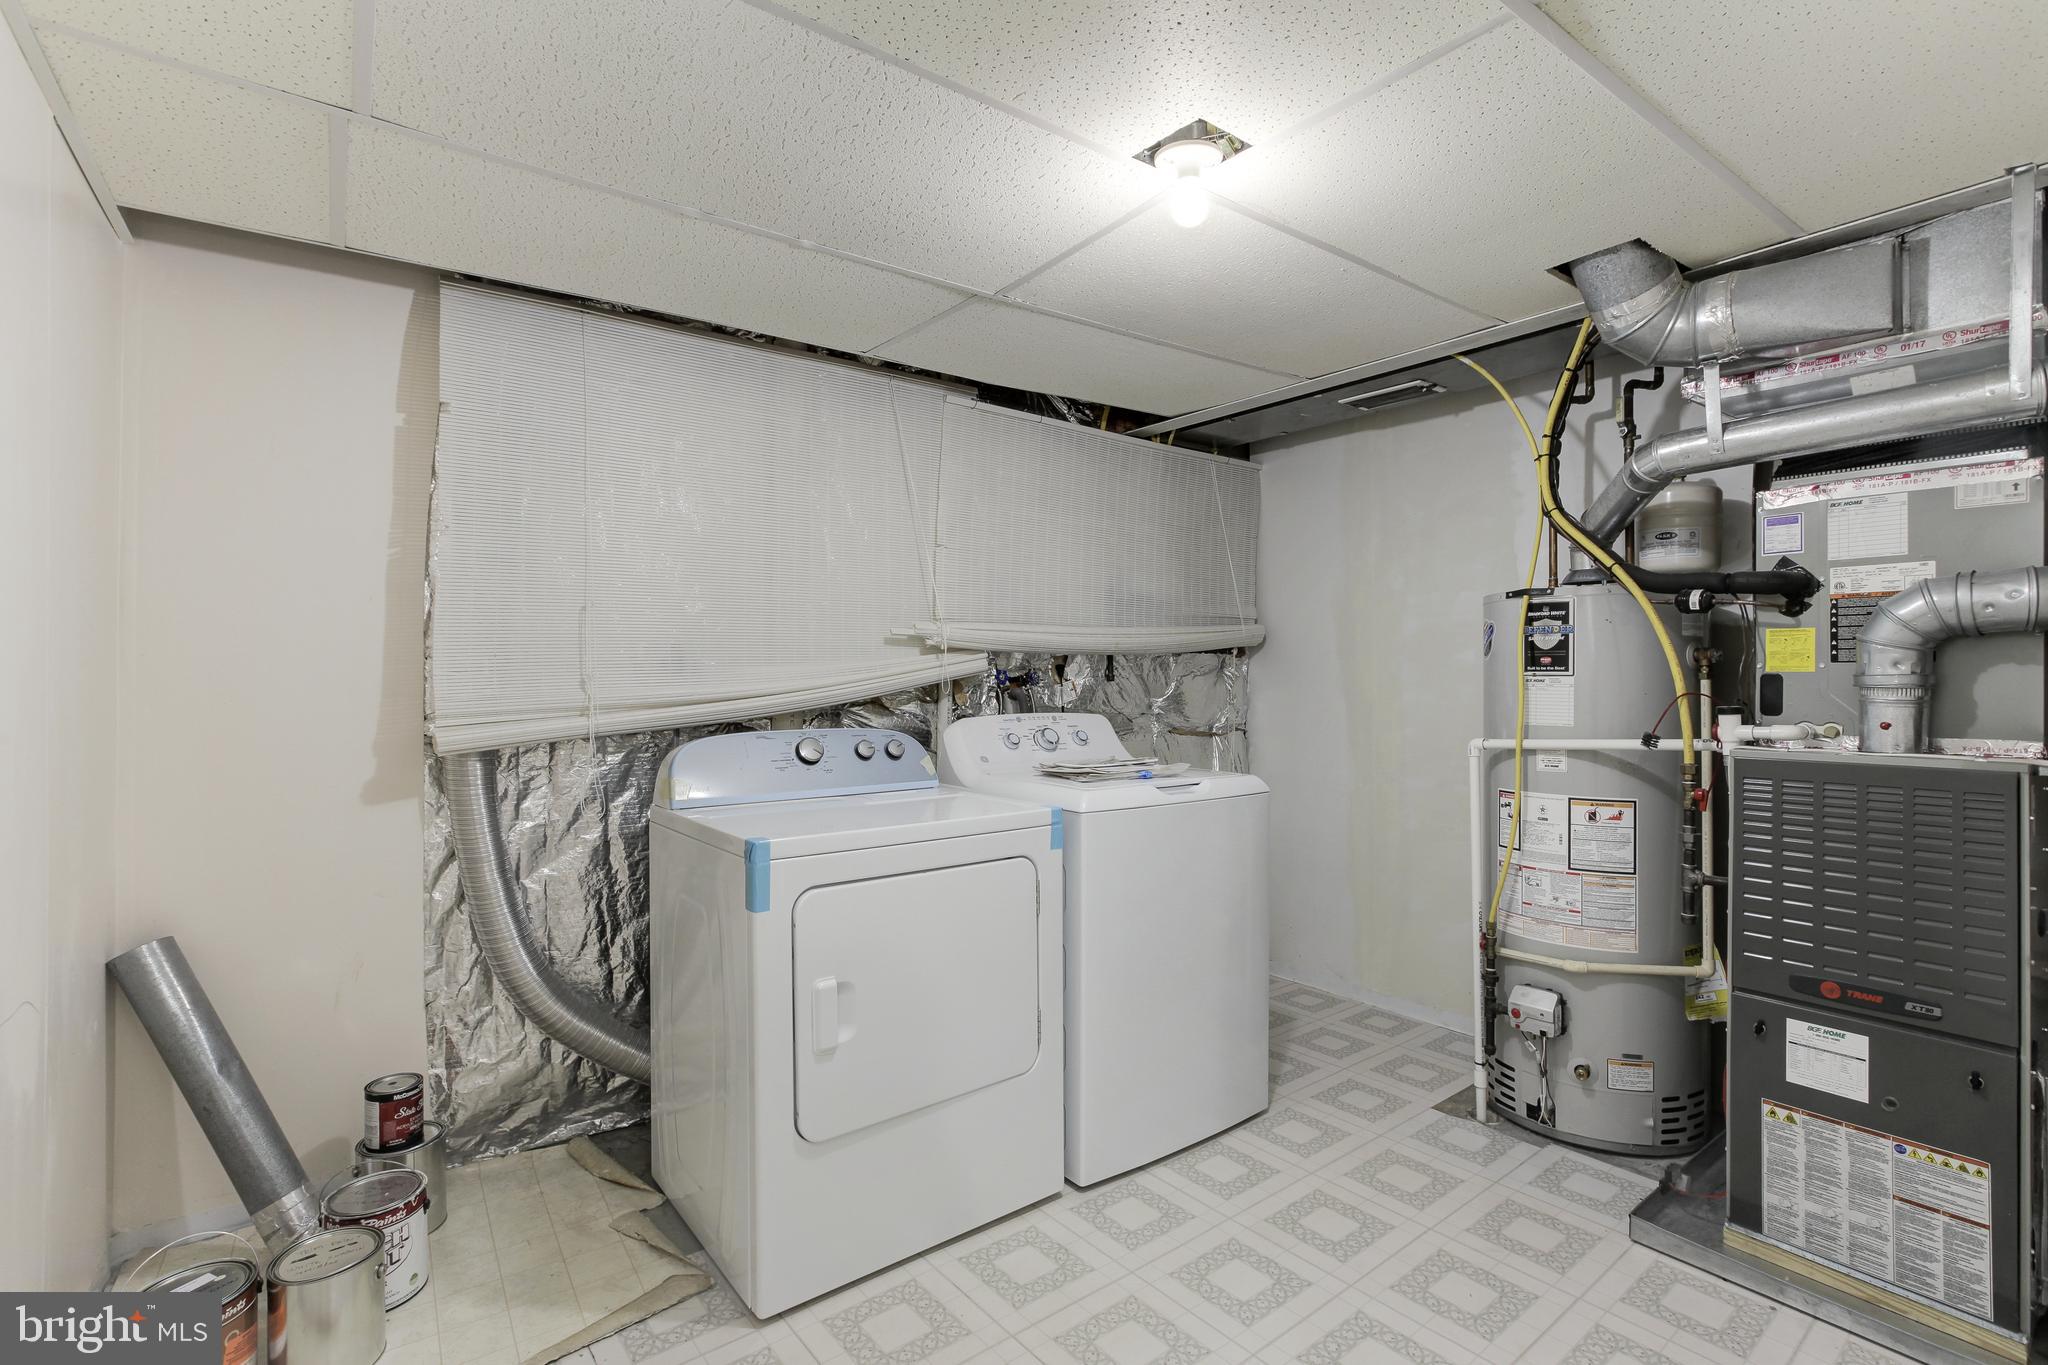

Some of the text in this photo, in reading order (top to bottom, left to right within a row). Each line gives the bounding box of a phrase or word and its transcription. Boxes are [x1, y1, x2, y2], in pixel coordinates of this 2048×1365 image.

[1900, 340, 1926, 351] 01/17
[1847, 989, 1884, 1004] TRANE
[1823, 1029, 1847, 1040] HOME
[361, 1208, 408, 1228] Paints
[221, 1298, 246, 1321] ints
